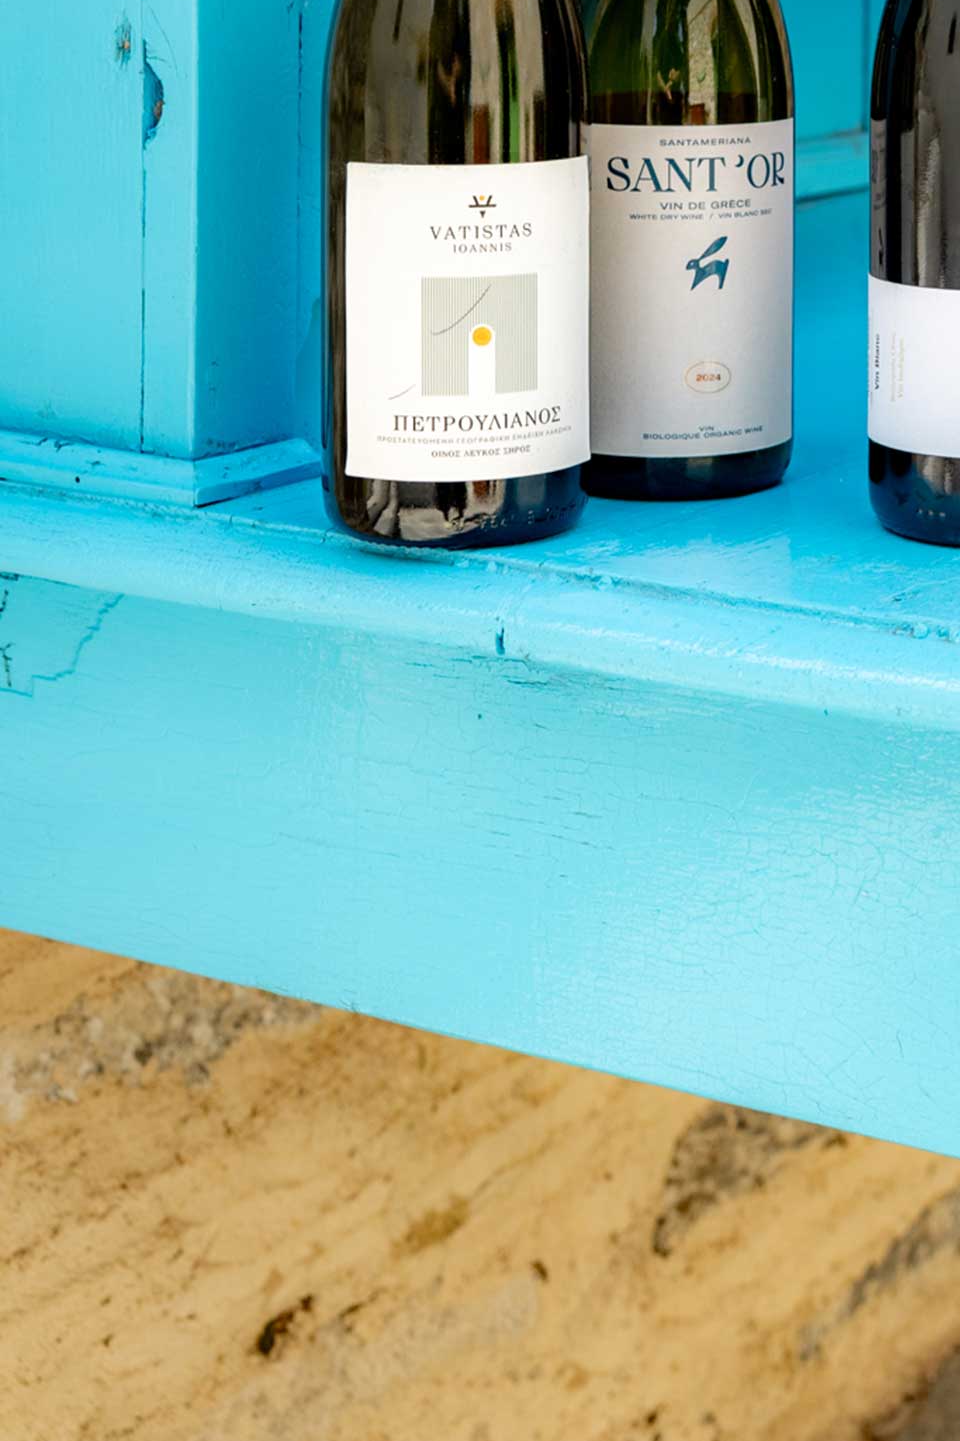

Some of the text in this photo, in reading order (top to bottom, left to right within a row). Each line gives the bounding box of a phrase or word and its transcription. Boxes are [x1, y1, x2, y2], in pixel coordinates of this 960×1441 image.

[659, 136, 751, 146] SANTAMERIANA
[606, 152, 785, 193] SANT'OR
[660, 202, 683, 211] VIN
[688, 201, 705, 210] DE
[430, 222, 532, 240] VATISTAS
[453, 242, 513, 254] IOANNIS
[393, 405, 562, 432] ΠΕΤΡΟΥΛΙΑΝΟΣ
[643, 425, 763, 441] BIOLOGIQUE ORGANIC WINE
